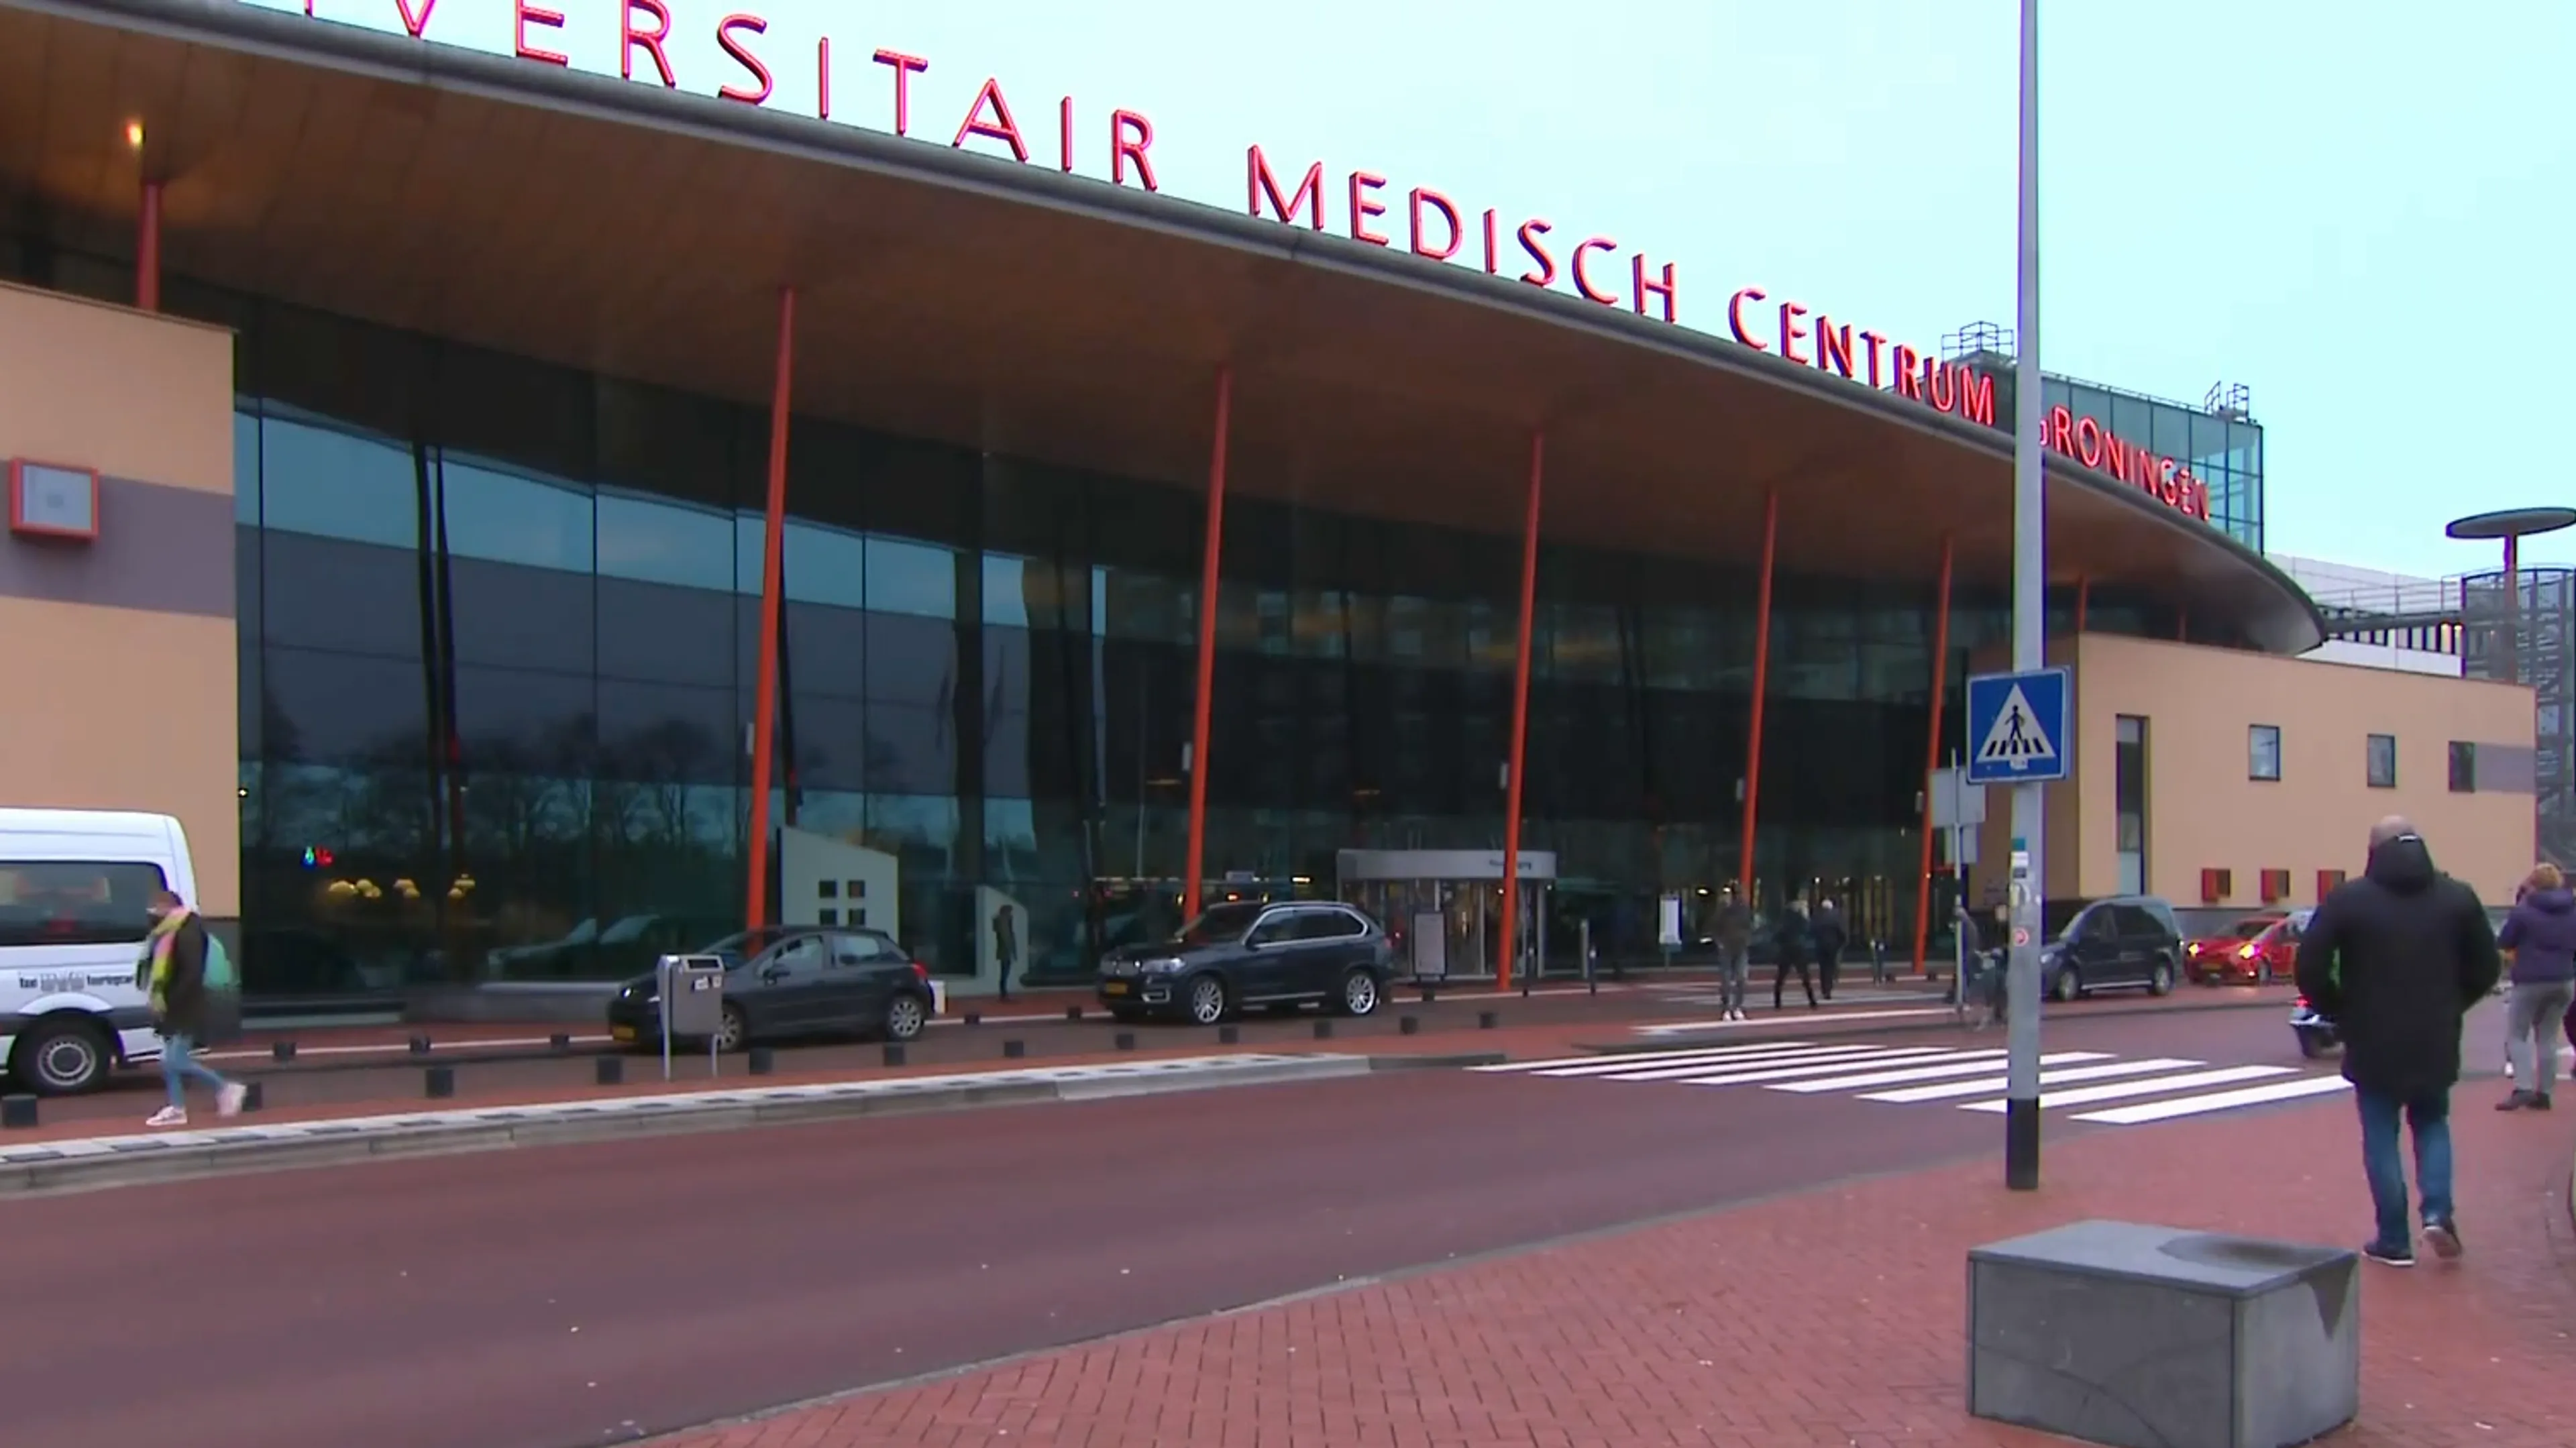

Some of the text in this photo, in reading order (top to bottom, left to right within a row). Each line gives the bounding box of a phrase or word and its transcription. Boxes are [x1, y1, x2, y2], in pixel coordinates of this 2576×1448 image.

[303, 0, 2210, 522] ERSITAIR MEDISCH CENTRUM RONINGEN
